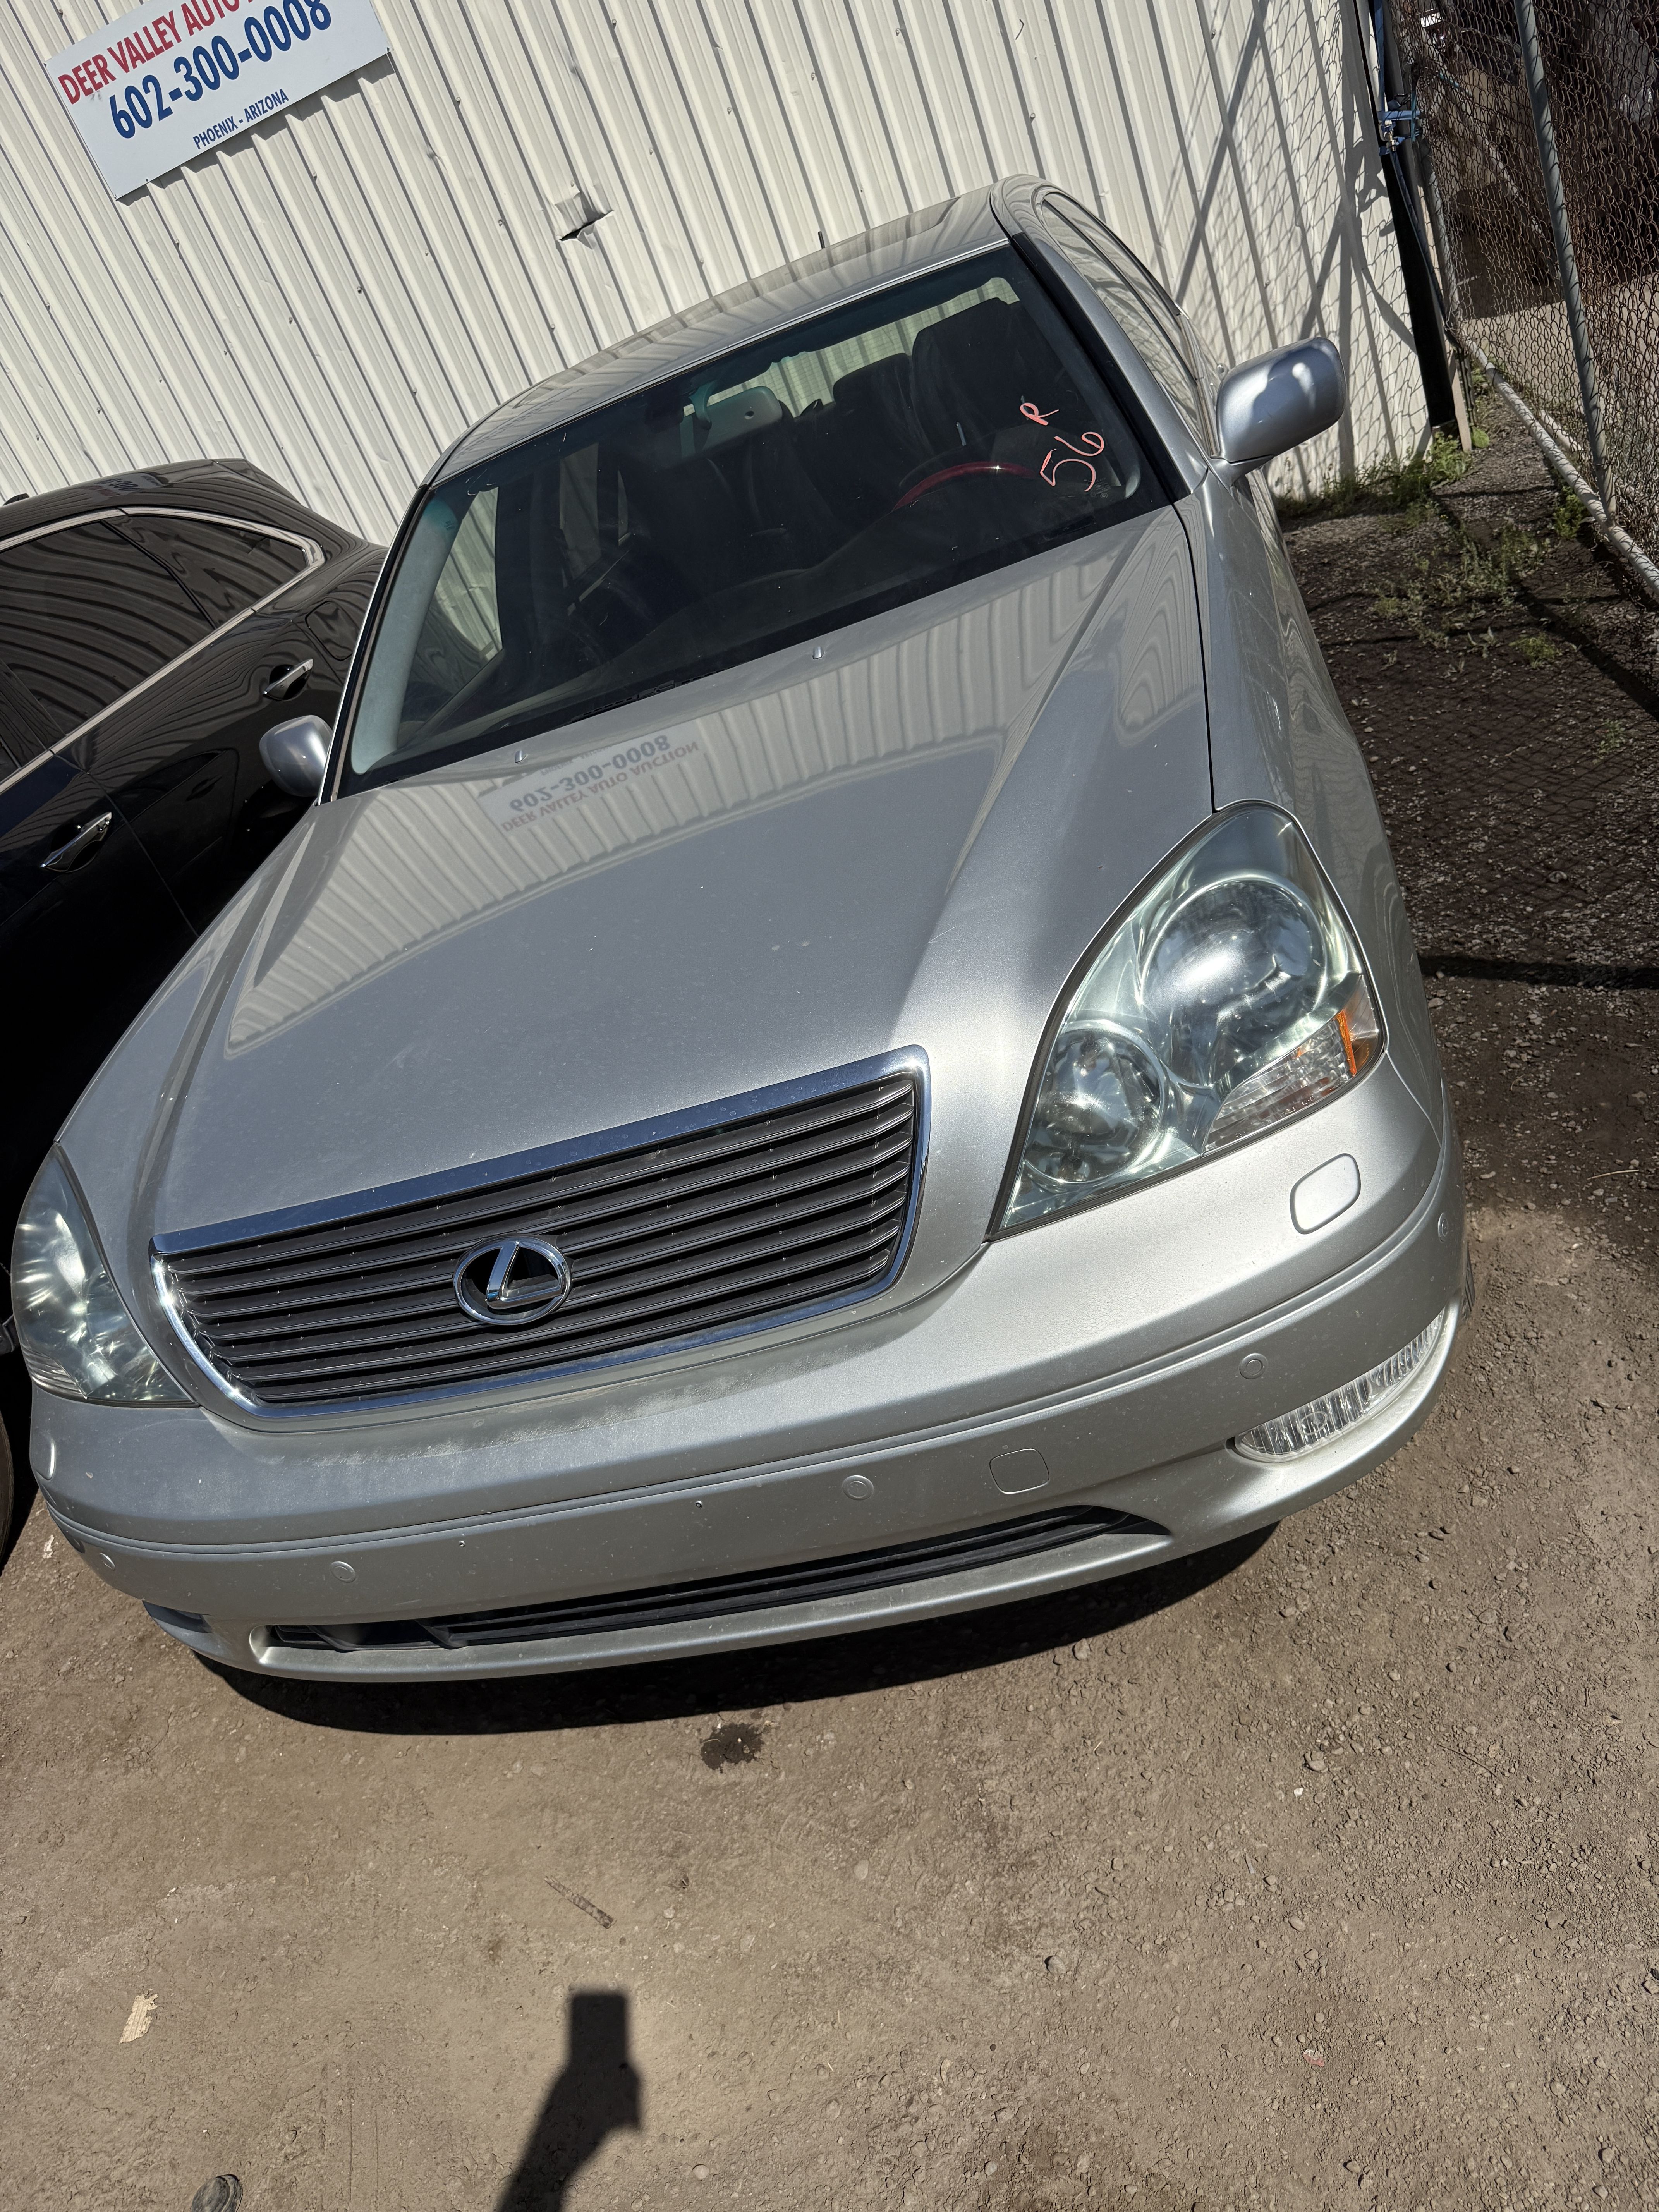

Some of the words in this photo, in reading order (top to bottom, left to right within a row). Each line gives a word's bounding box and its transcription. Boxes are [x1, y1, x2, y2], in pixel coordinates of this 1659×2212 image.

[58, 54, 116, 104] DEER
[107, 10, 182, 73] VALLEY
[109, 0, 331, 139] 602-300-0008
[193, 115, 238, 149] PHOENIX
[244, 89, 289, 122] ARIZONA
[1040, 431, 1104, 492] 56
